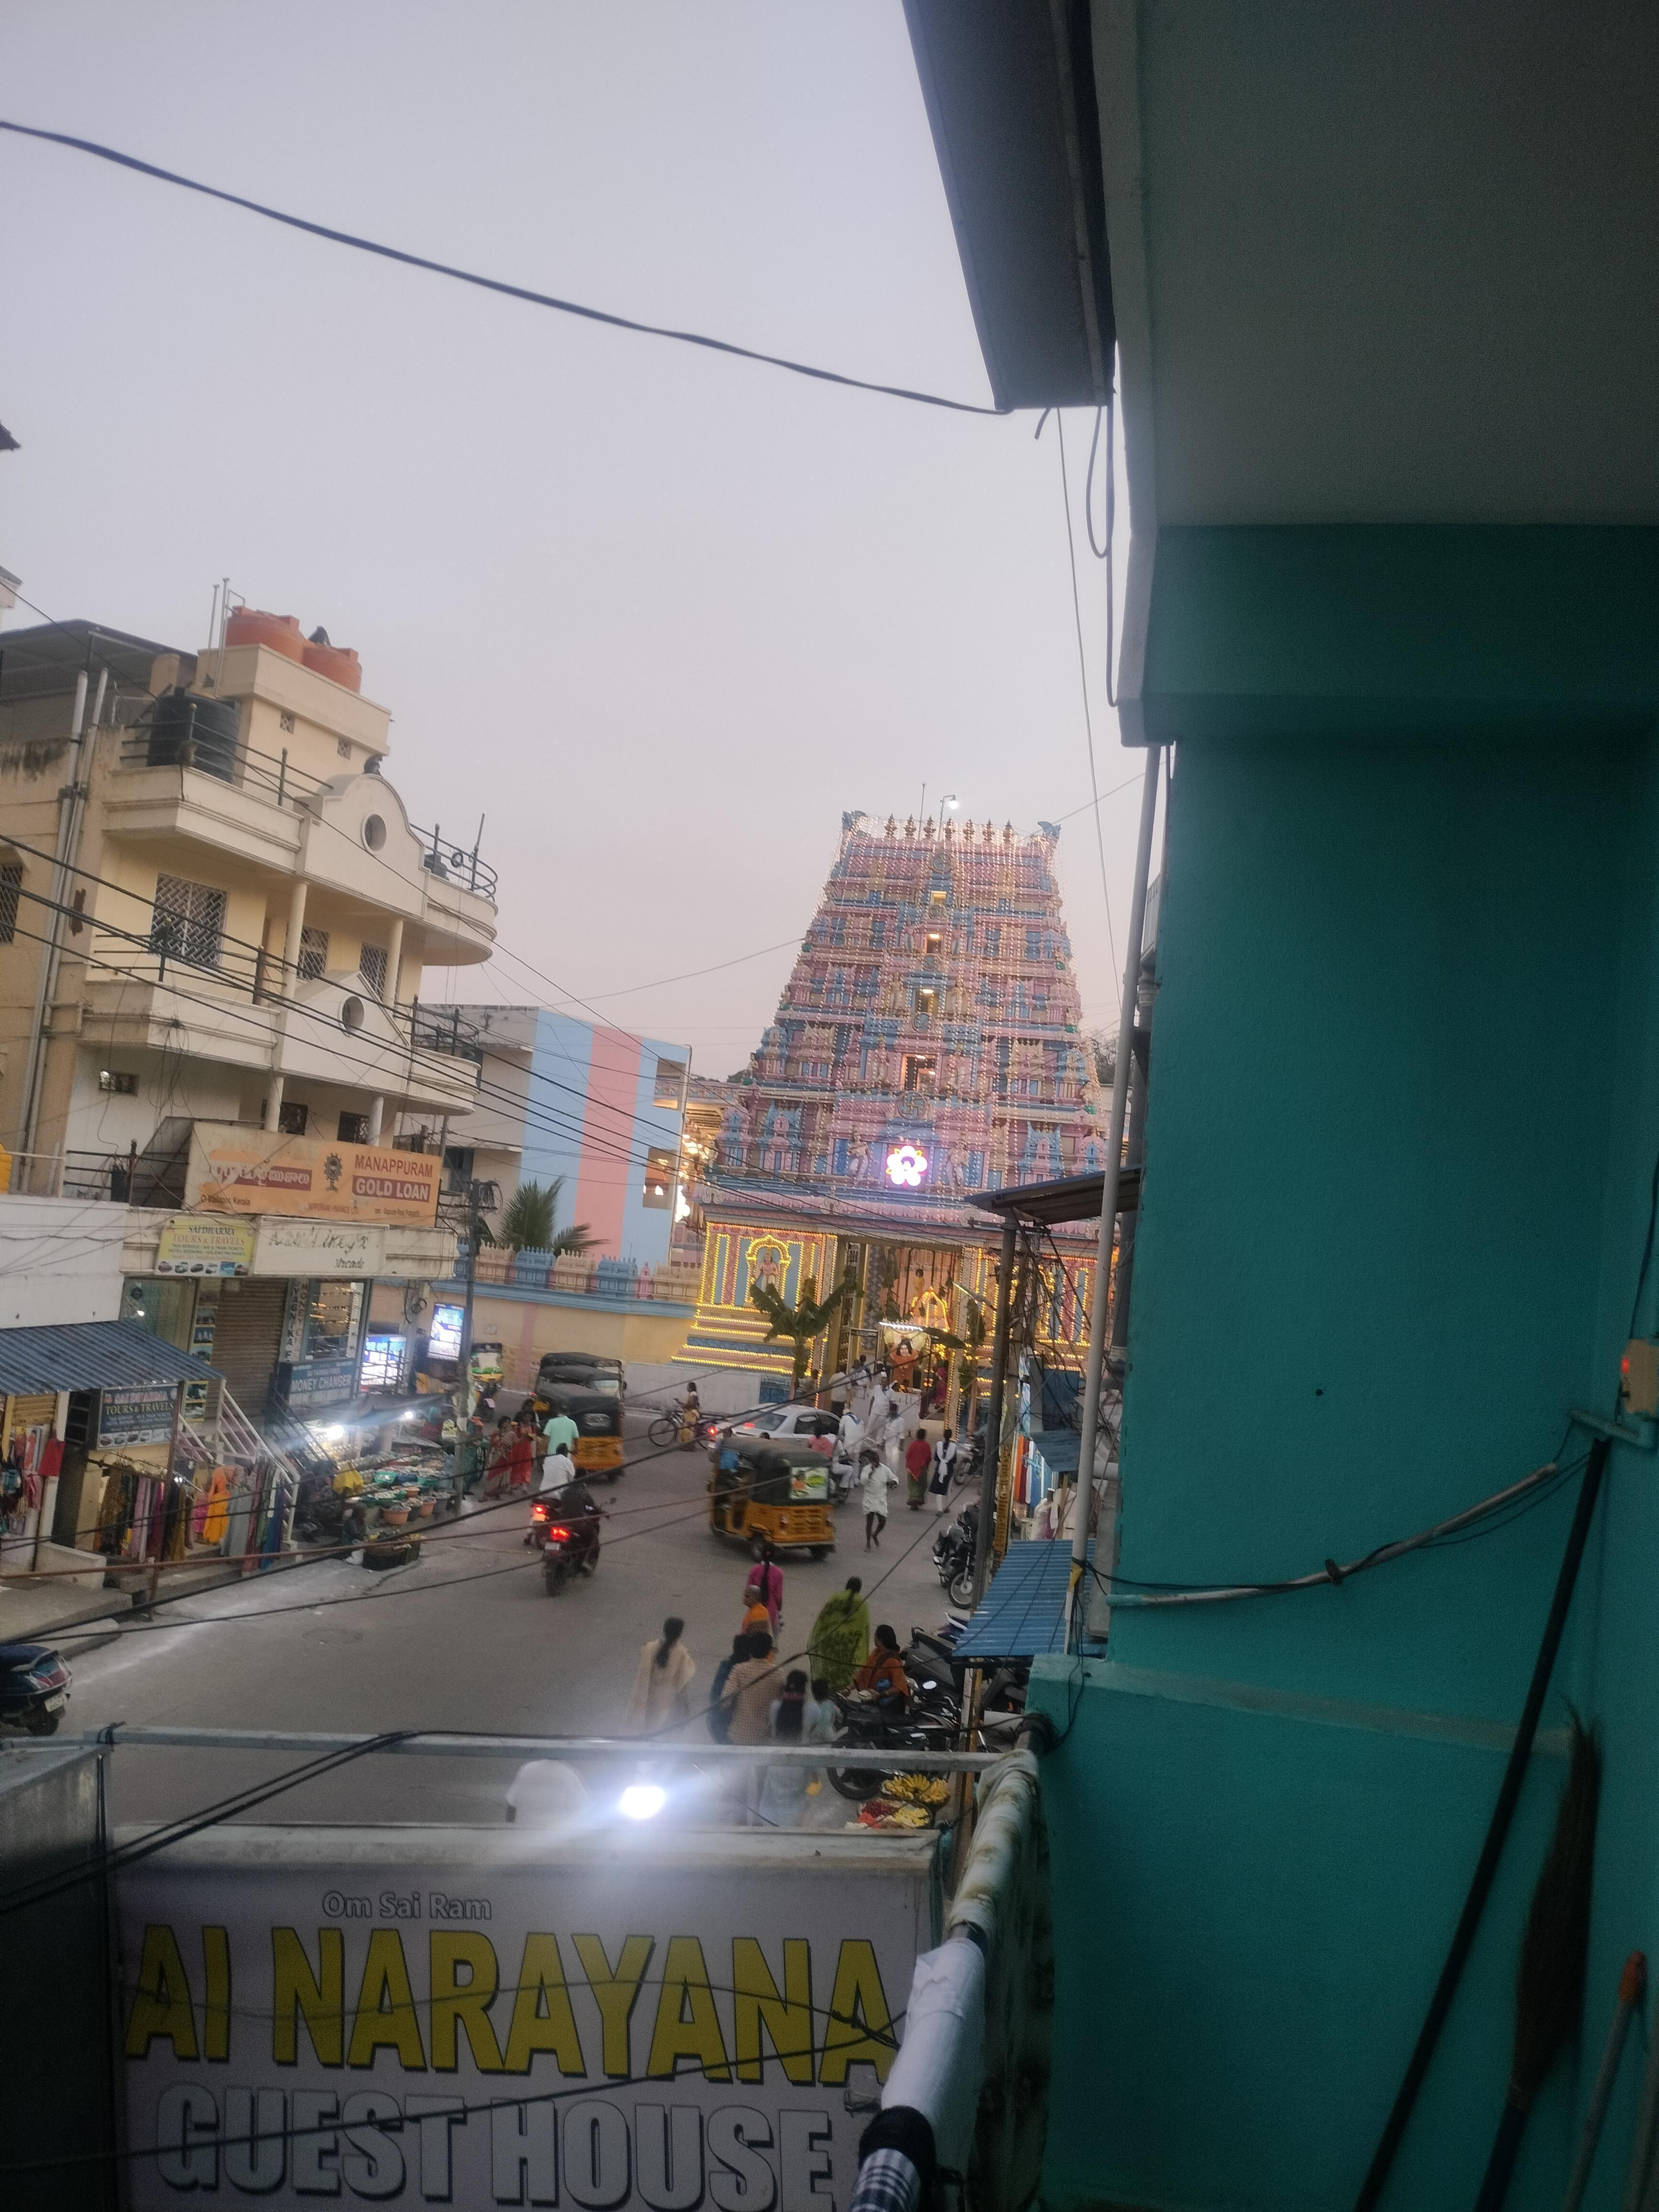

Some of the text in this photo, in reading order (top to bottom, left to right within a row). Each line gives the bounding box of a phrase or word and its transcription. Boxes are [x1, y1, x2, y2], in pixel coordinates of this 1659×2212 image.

[355, 1154, 433, 1178] MANAPPURAM
[356, 1178, 429, 1200] GOLD LOAN
[173, 1234, 202, 1244] TOURS
[211, 1235, 245, 1246] TRAVELS
[198, 1226, 235, 1236] DHARMA
[291, 1374, 352, 1393] MONEY CHANGER
[105, 1404, 133, 1415] TOURS
[141, 1401, 174, 1412] TRAVELS
[322, 1890, 492, 1920] Om Sai Ram
[271, 1926, 899, 2087] NARAYANA
[156, 2081, 837, 2212] GUEST HOUSE
